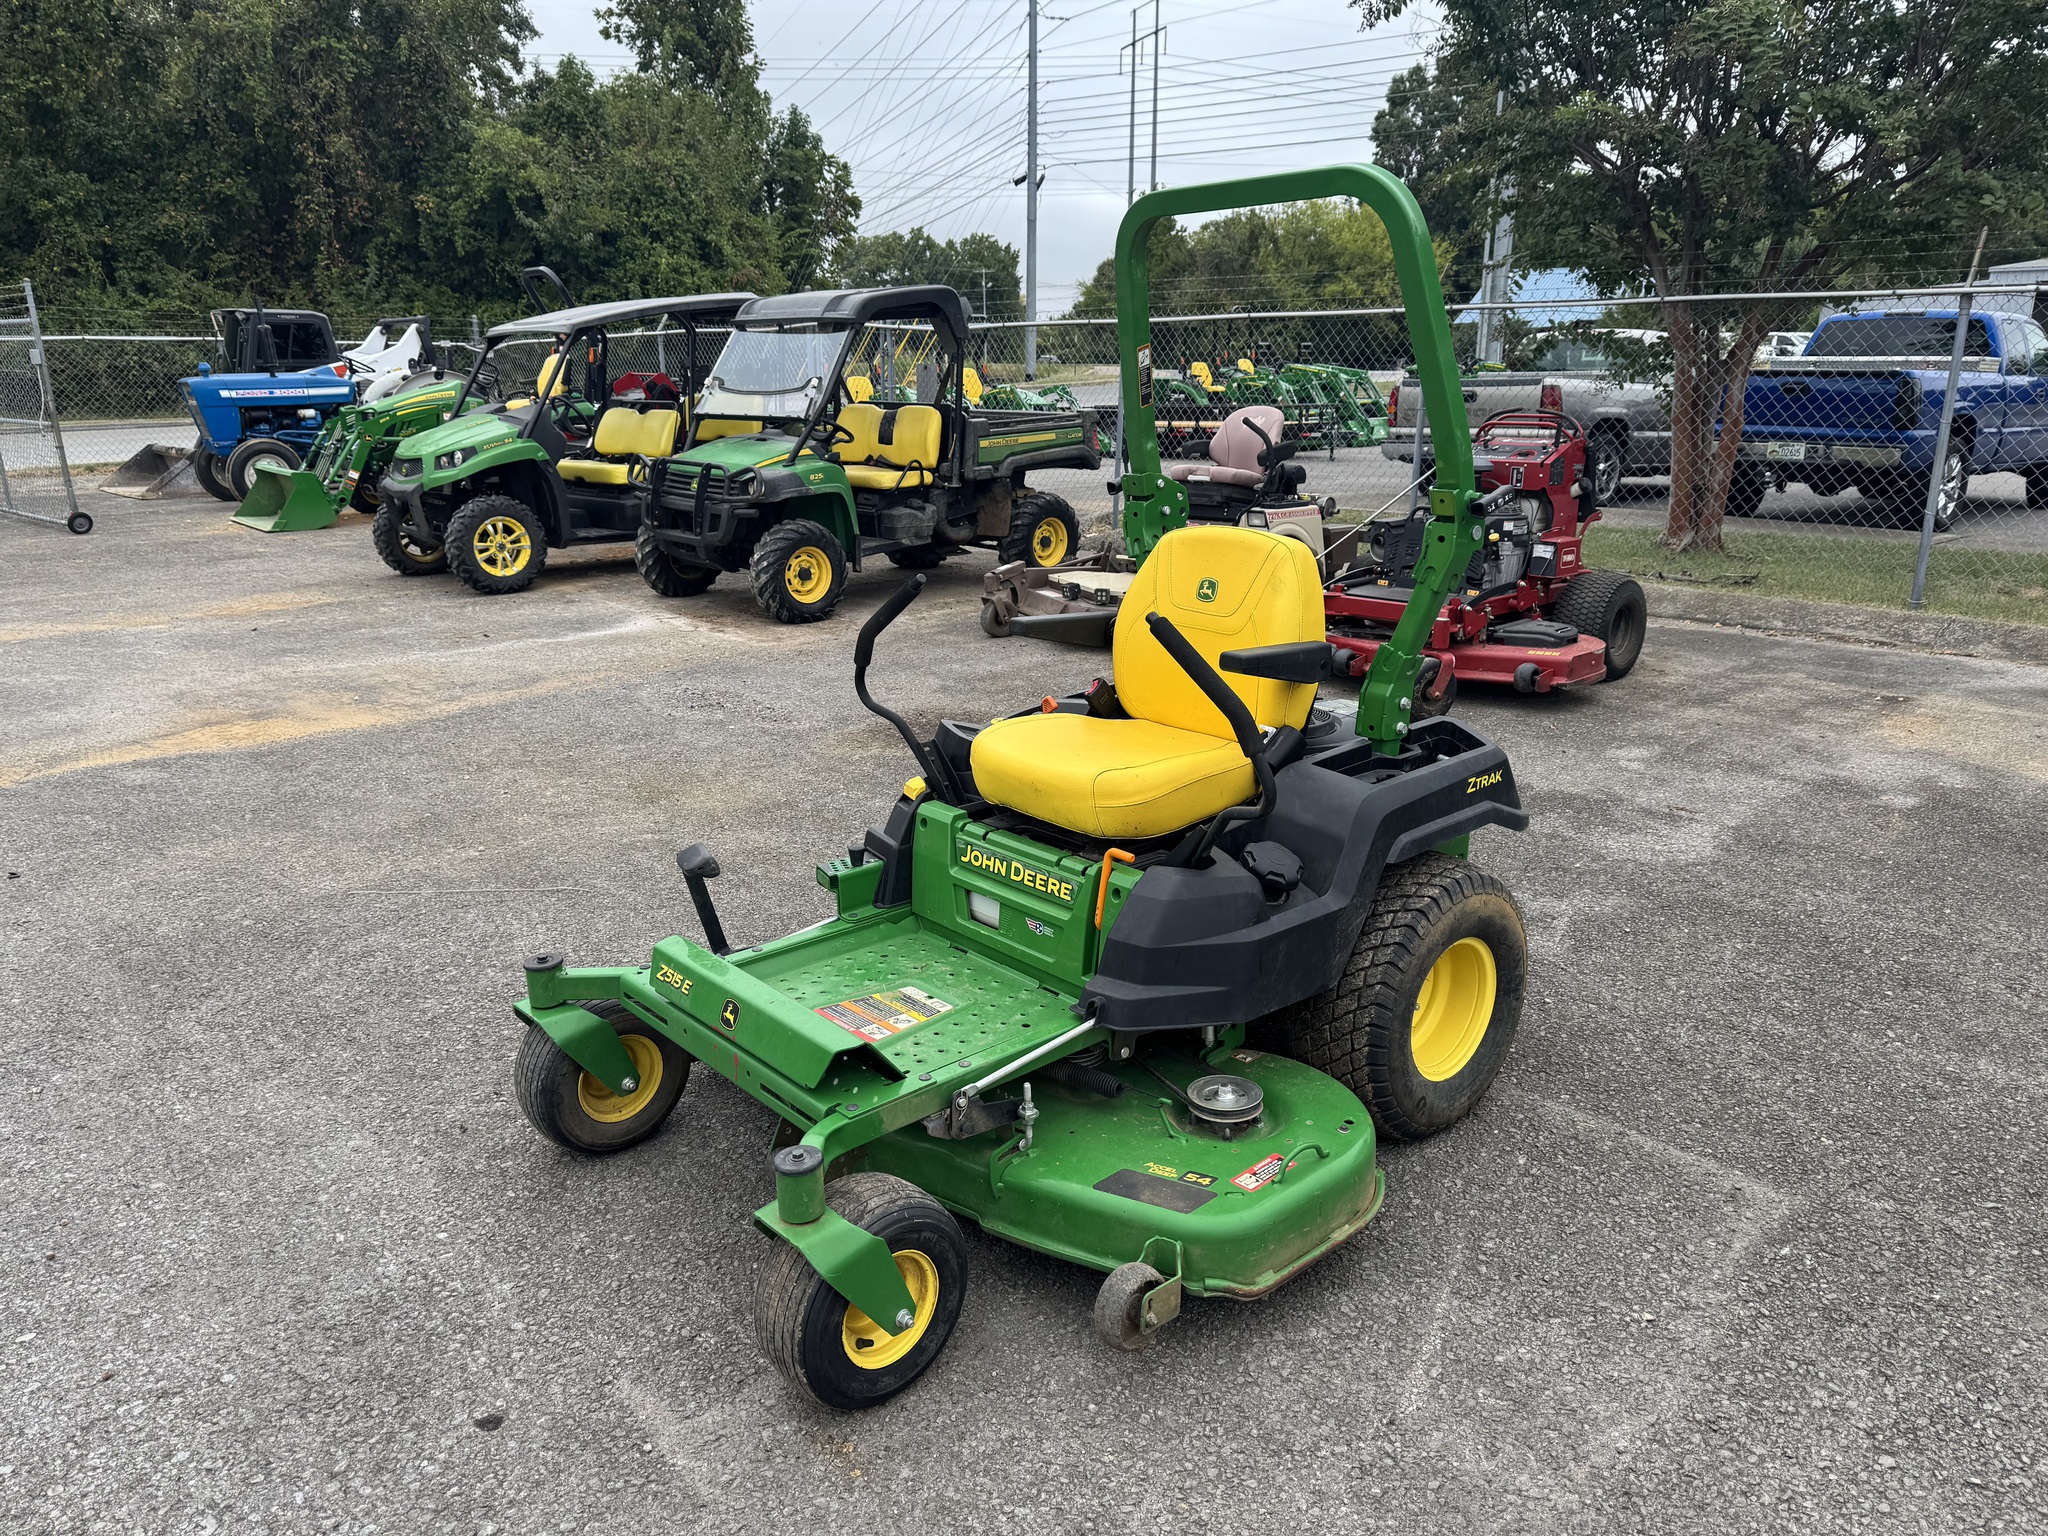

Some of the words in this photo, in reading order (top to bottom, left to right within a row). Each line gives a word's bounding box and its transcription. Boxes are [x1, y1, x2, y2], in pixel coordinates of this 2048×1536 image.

[987, 439, 1001, 448] JOHN
[1002, 437, 1019, 446] DEERE
[1466, 769, 1503, 794] ZTRAK
[960, 844, 1007, 877] JOHN
[1010, 860, 1073, 902] DEERE
[656, 963, 684, 989] Z515
[681, 979, 694, 996] E
[1143, 1161, 1178, 1174] ACCEL
[1182, 1172, 1213, 1186] 54
[1148, 1167, 1179, 1178] DEEP
